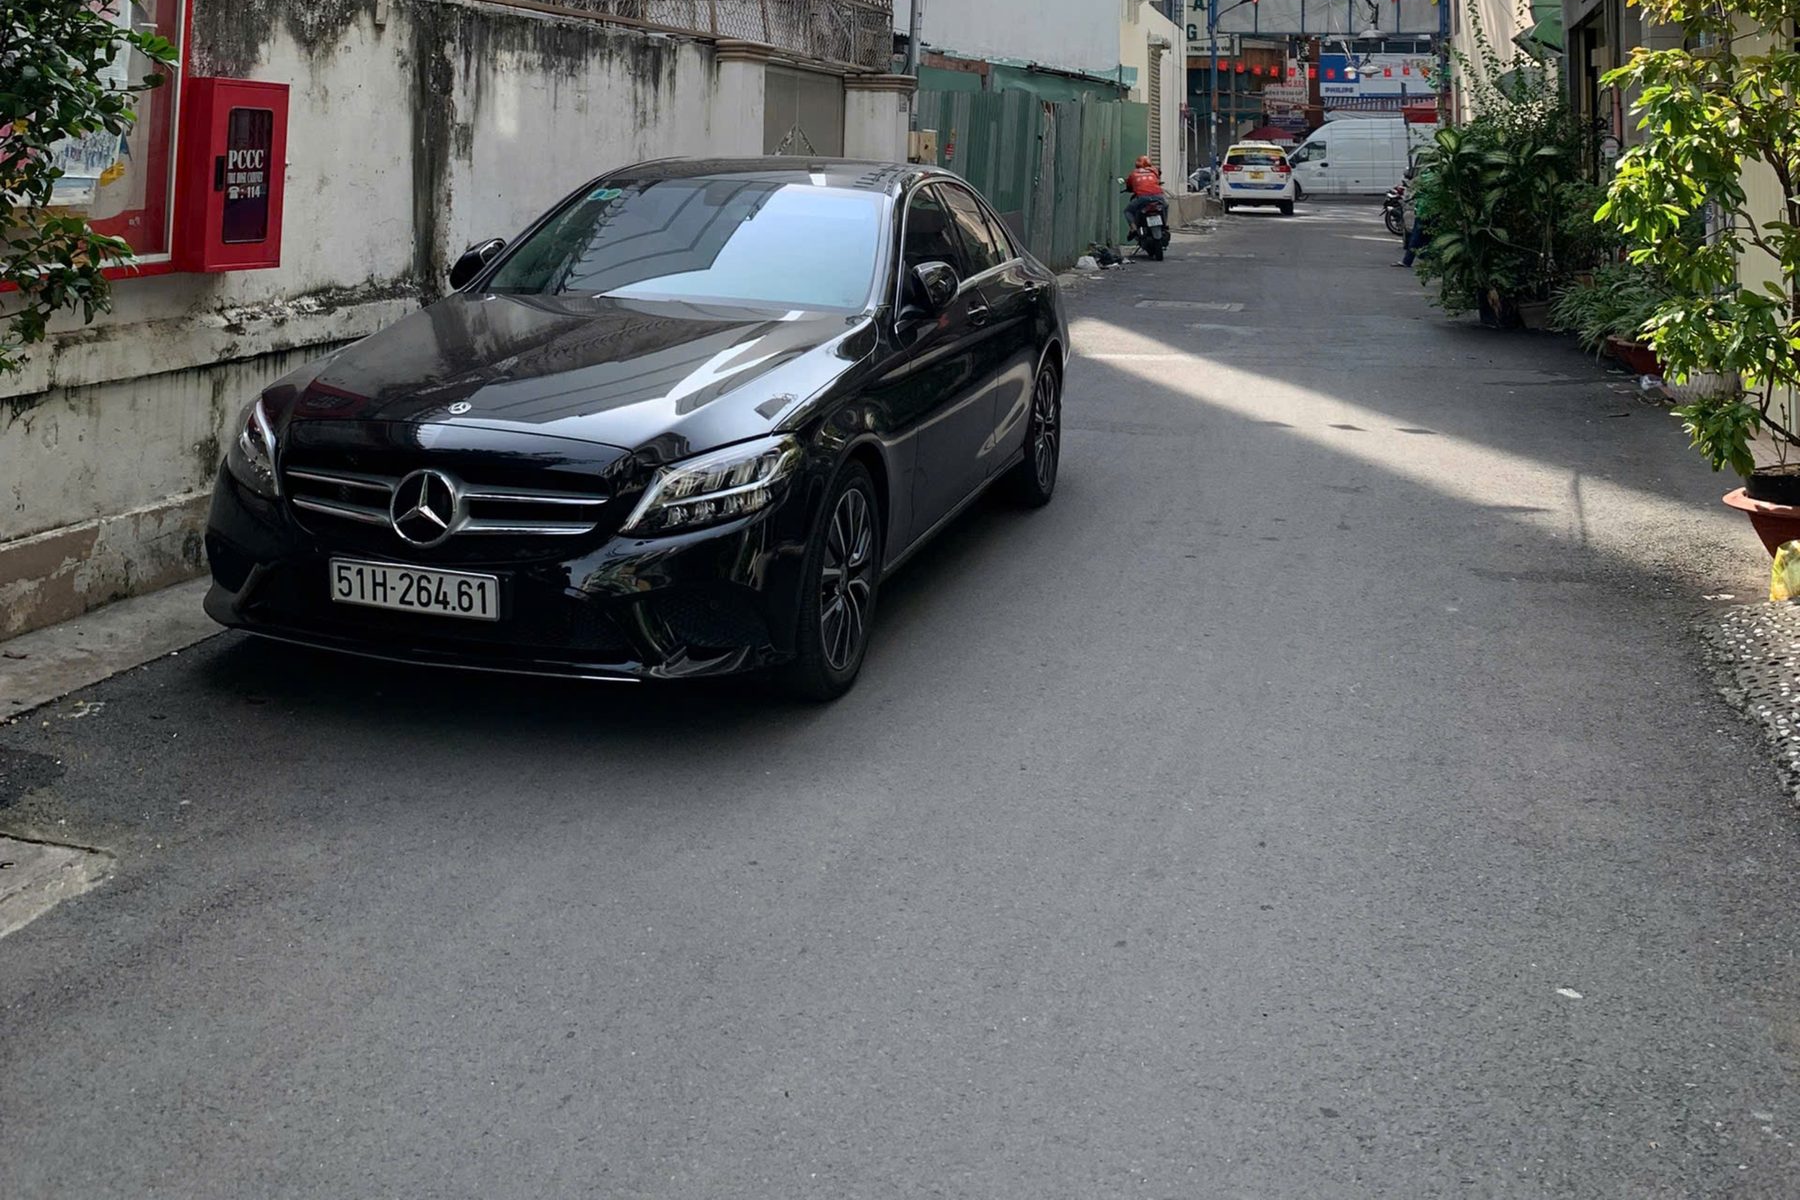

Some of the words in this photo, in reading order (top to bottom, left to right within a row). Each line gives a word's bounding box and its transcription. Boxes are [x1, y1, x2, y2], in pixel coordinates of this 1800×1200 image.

[1324, 86, 1354, 94] PHILIPS
[227, 149, 264, 170] PCCC
[337, 565, 488, 615] 51H-264.61
